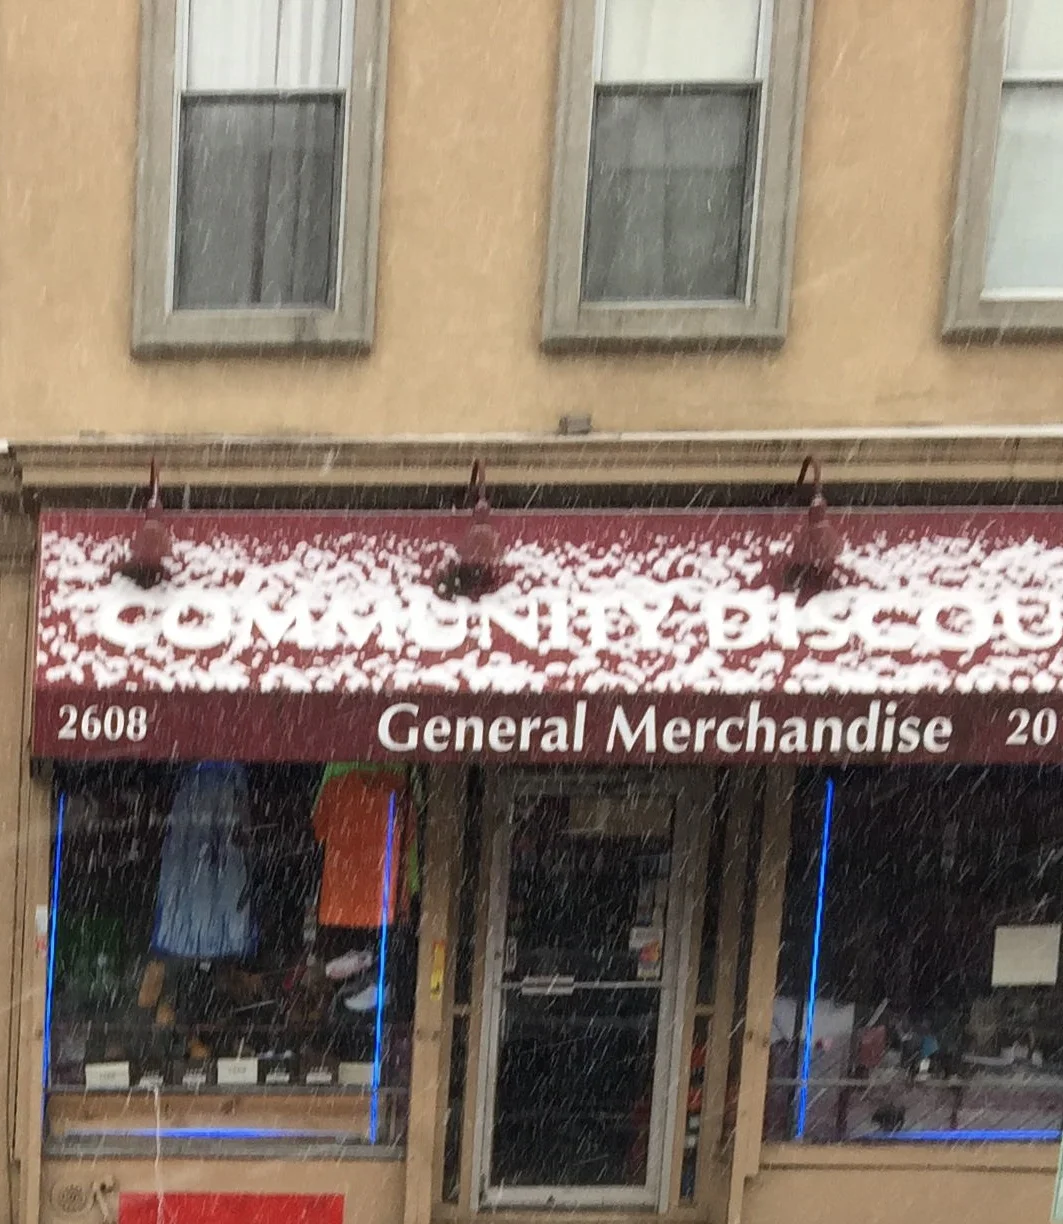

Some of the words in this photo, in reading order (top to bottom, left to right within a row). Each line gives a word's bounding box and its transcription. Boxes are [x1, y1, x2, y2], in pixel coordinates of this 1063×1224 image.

[96, 587, 679, 651] COMMUNITY
[57, 704, 148, 742] 2608
[377, 700, 587, 753] General
[605, 699, 953, 755] Merchandise
